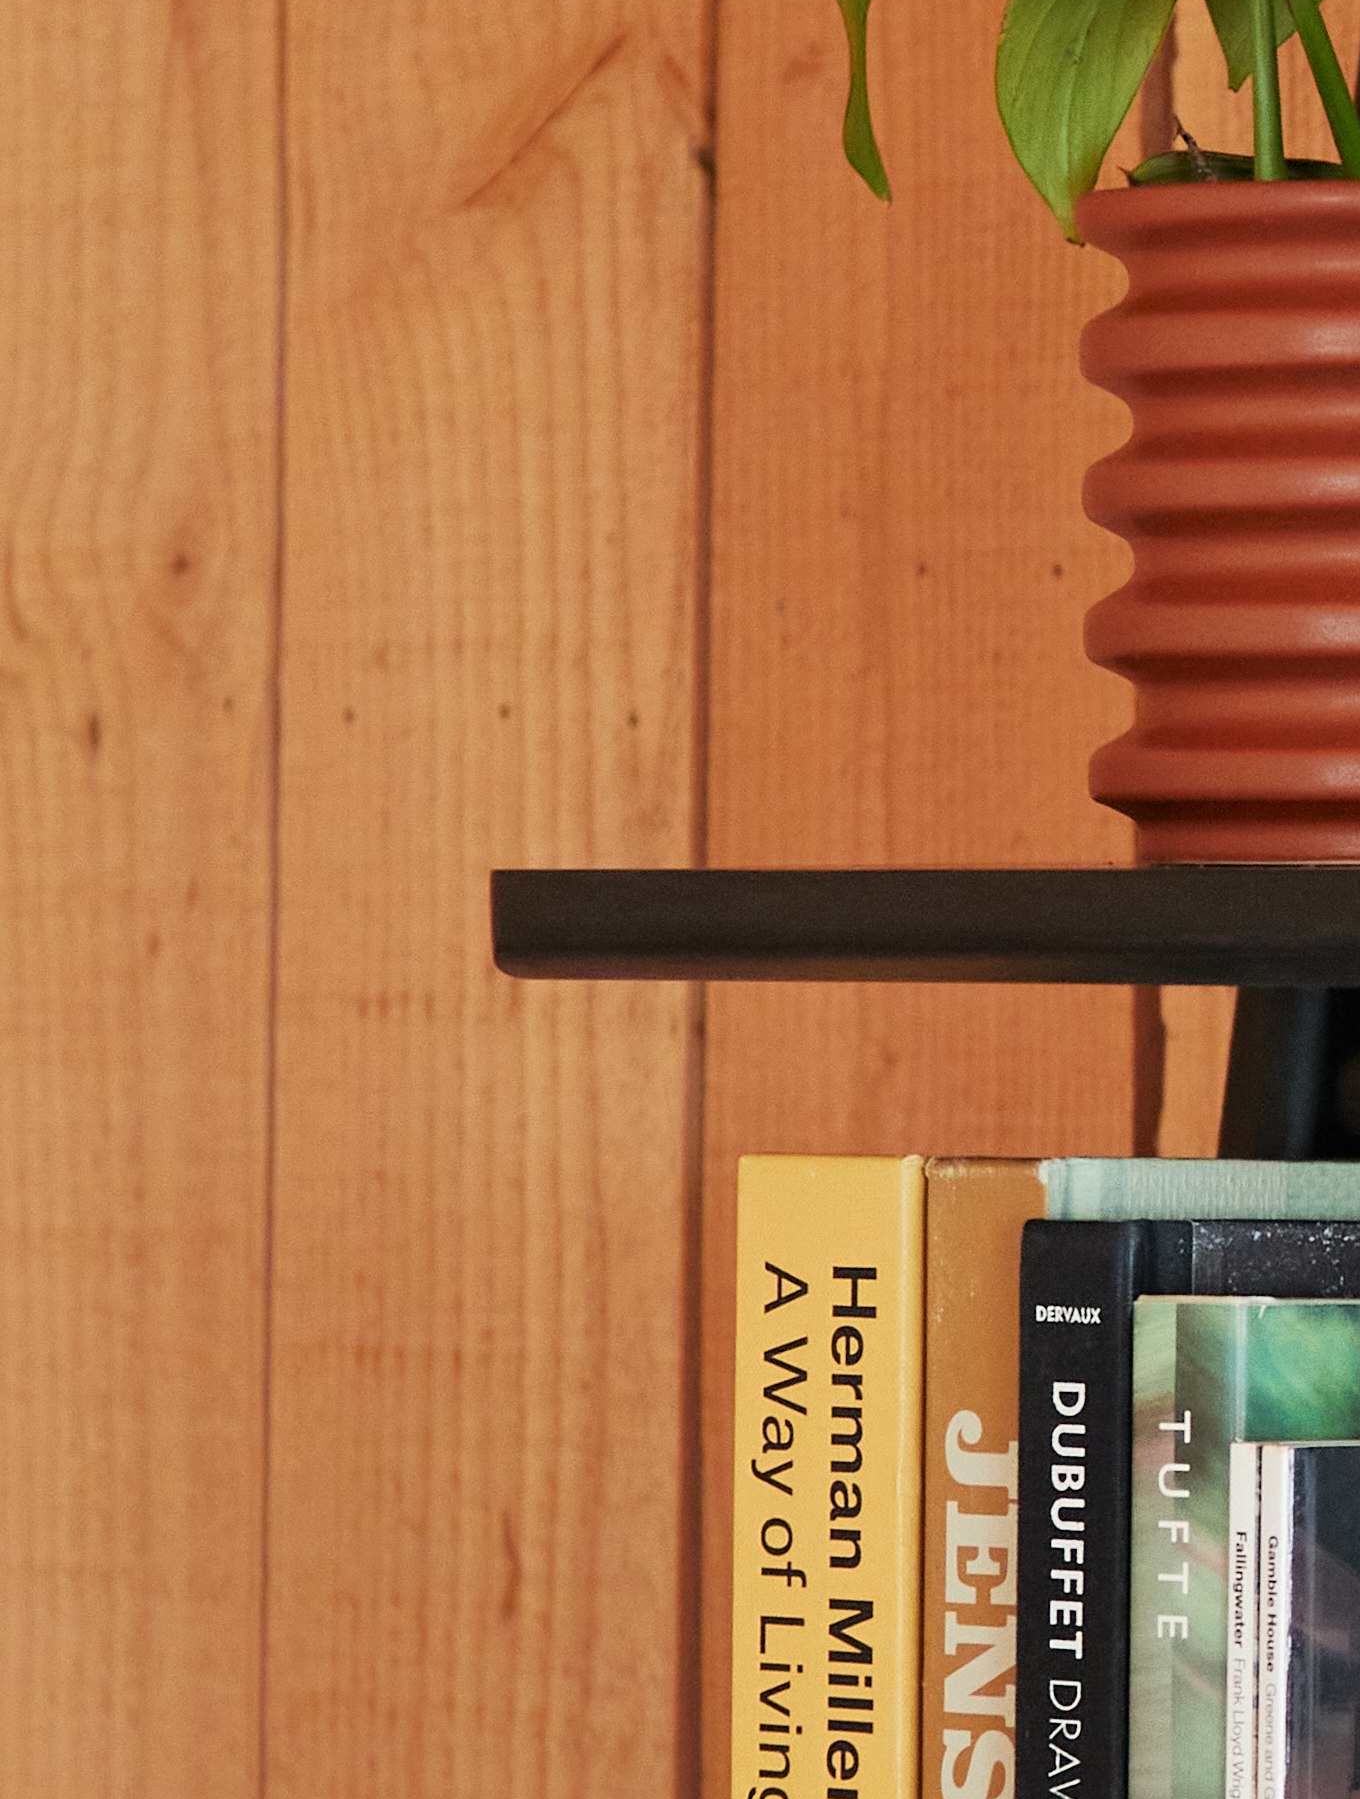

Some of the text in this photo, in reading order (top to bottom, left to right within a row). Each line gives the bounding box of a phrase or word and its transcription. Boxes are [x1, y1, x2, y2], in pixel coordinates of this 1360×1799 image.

[763, 1261, 809, 1316] A
[1035, 1304, 1102, 1326] DERVAUX
[751, 1336, 809, 1496] Way
[827, 1266, 878, 1570] Herman
[1048, 1381, 1087, 1661] DUBUFFET
[1158, 1410, 1190, 1642] TUFTE
[759, 1521, 806, 1588] of
[1266, 1536, 1278, 1608] Gamble
[1233, 1531, 1247, 1648] Fallingwater
[1266, 1612, 1276, 1672] House
[1233, 1658, 1246, 1707] Frank
[1265, 1682, 1276, 1746] Greene
[1231, 1710, 1242, 1757] Lloyd
[1264, 1750, 1274, 1782] and
